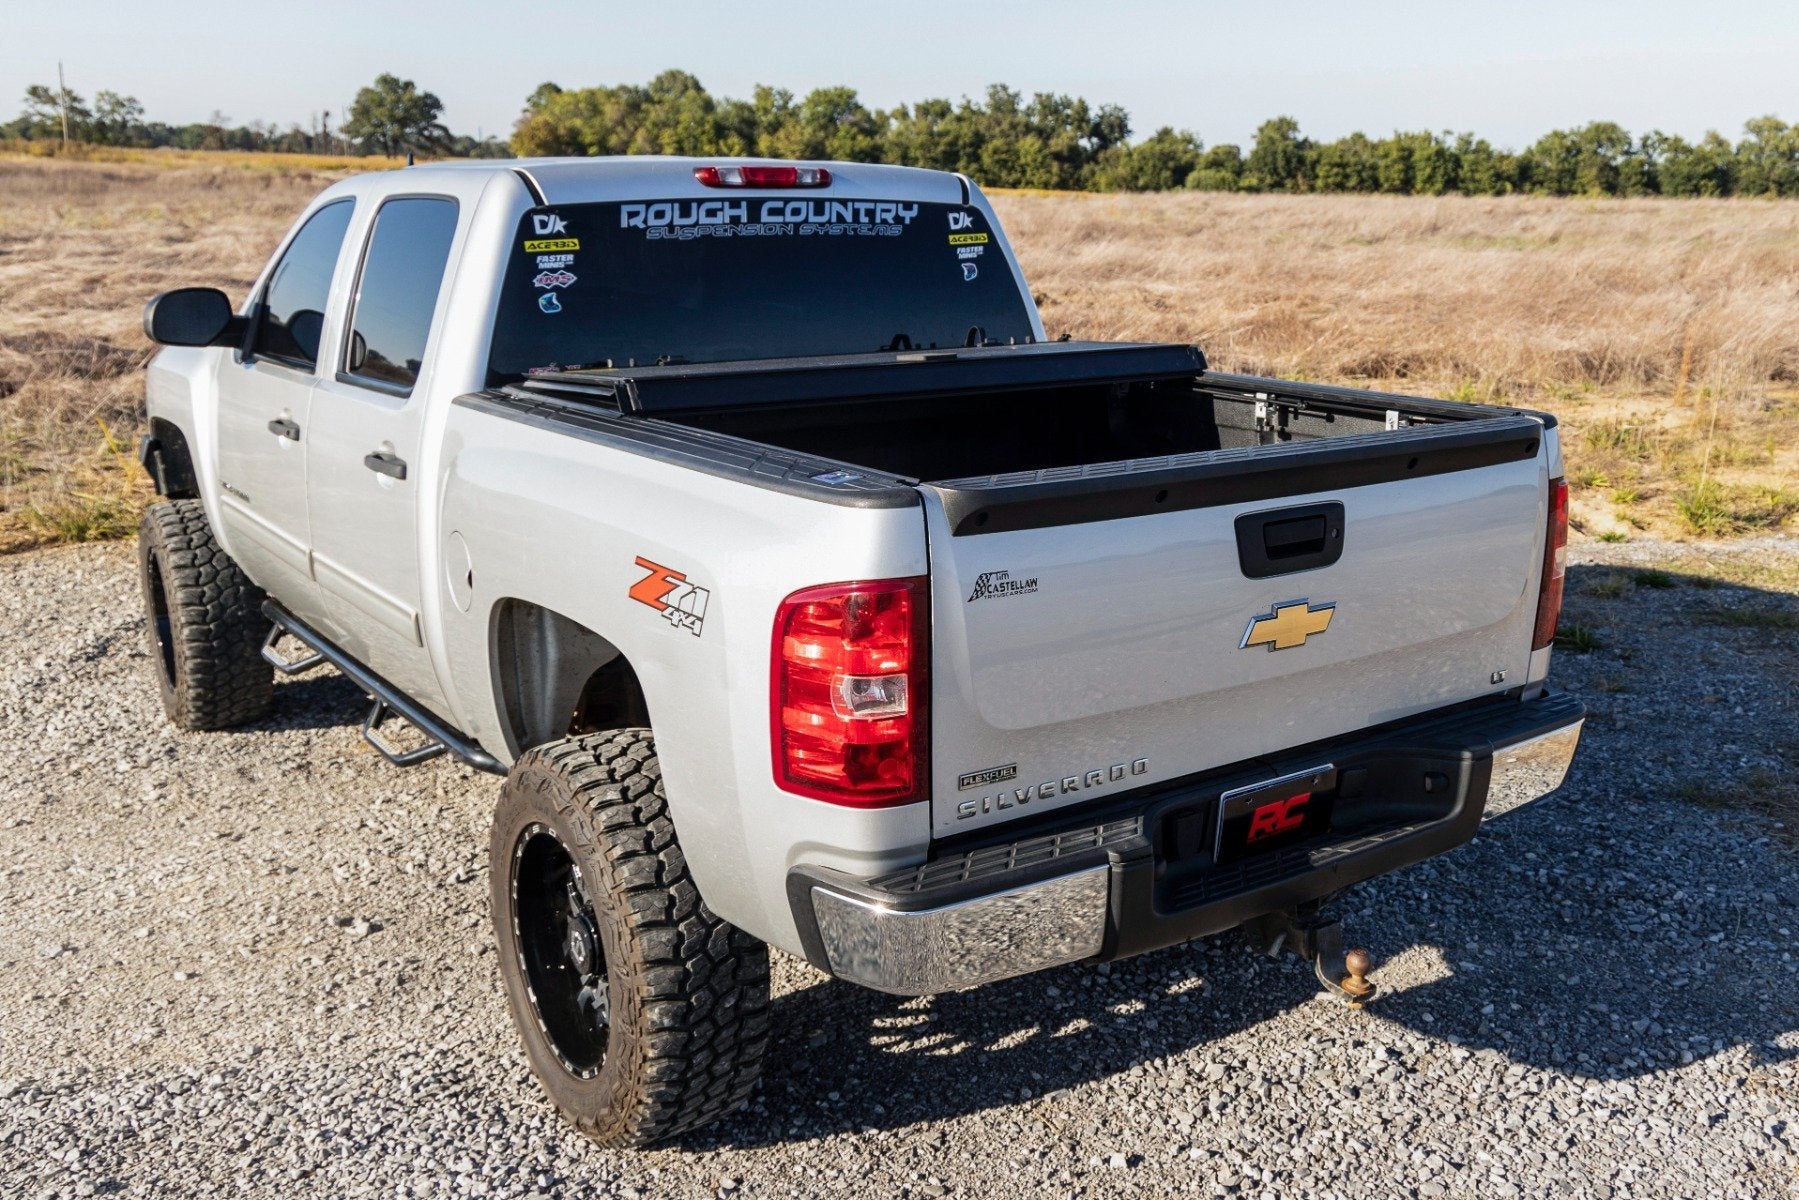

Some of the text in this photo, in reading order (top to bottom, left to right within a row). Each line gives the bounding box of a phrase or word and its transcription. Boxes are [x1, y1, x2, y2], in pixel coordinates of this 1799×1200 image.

[620, 201, 919, 228] ROUGH COUNTRY
[646, 223, 903, 241] SUSPENSION SYSTEMS
[536, 254, 574, 264] FASTER
[628, 554, 710, 622] Z71
[986, 577, 1038, 594] CASTELLAW
[1490, 669, 1508, 685] LT
[962, 765, 1017, 787] FLEXFUEL
[957, 757, 1150, 820] SILVERADO
[1247, 791, 1312, 843] RC
